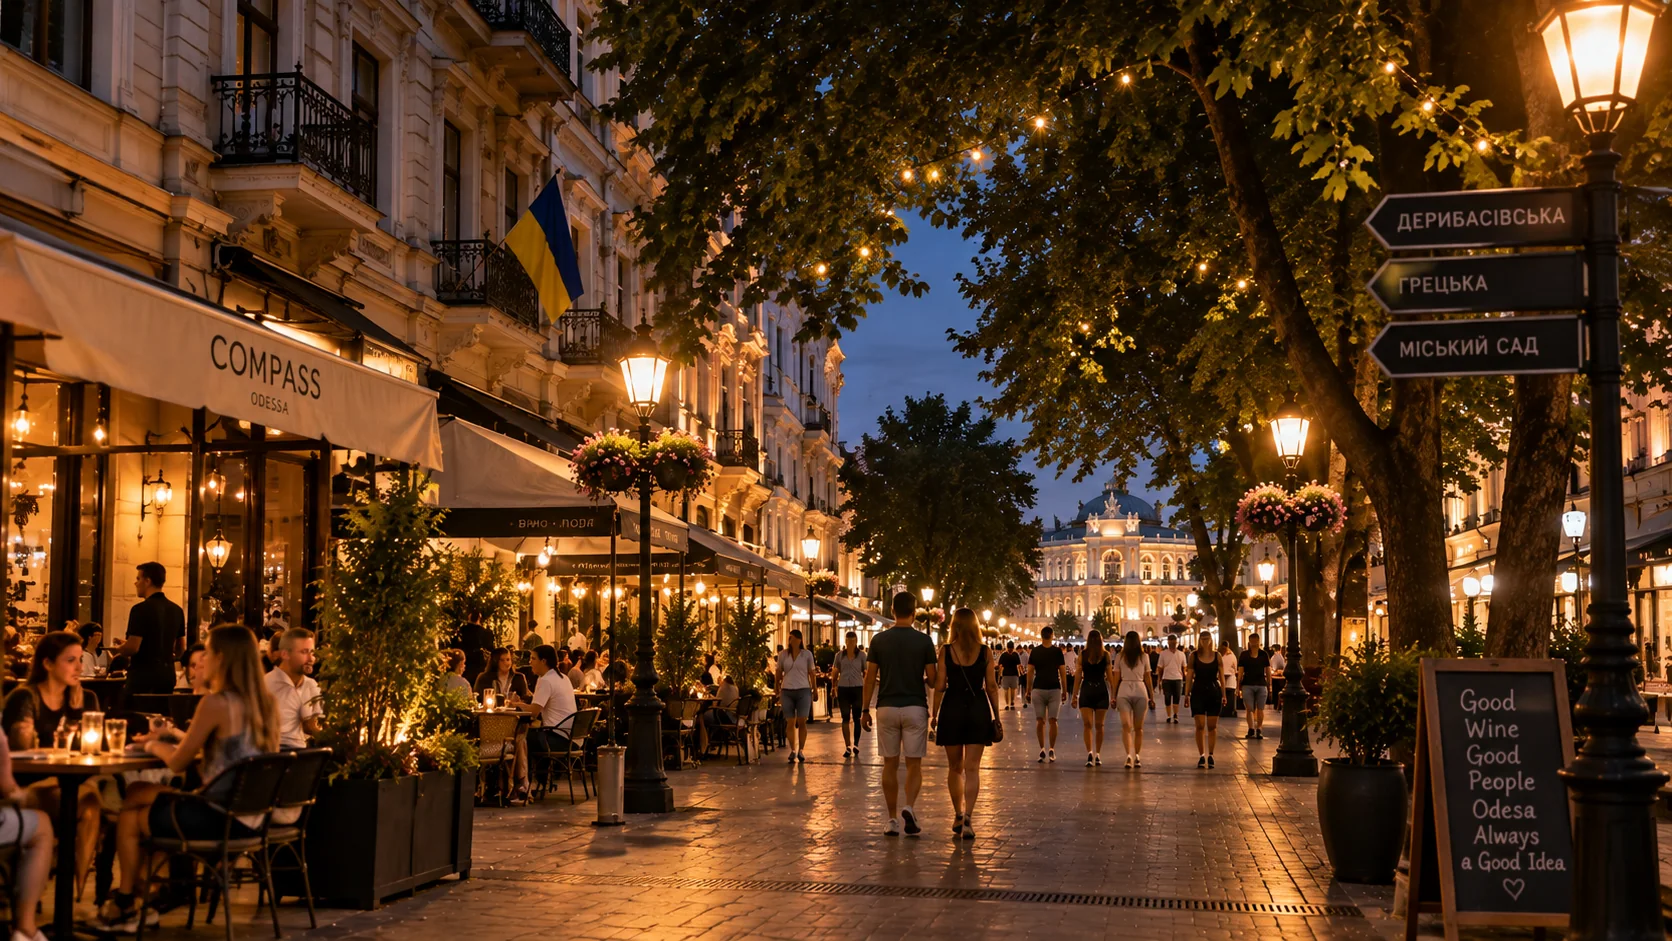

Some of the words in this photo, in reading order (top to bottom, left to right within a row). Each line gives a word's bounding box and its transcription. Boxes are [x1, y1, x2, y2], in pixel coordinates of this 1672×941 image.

[1397, 206, 1566, 232] ДЕРИБАСІВСЬКА
[1398, 274, 1488, 295] ГРЕЦЬКА
[1399, 335, 1488, 358] МІСЬКИЙ
[1497, 336, 1539, 356] САД
[210, 334, 321, 400] COMPASS
[250, 391, 289, 415] ODESSA
[1460, 688, 1517, 714] Good
[1464, 718, 1520, 739] Wine
[1466, 744, 1521, 767] Good
[1468, 770, 1536, 797] People
[1472, 798, 1537, 819] Odesa
[1473, 824, 1540, 851] Always
[1460, 856, 1473, 871] a
[1478, 850, 1521, 873] Good
[1527, 851, 1567, 871] Idea
